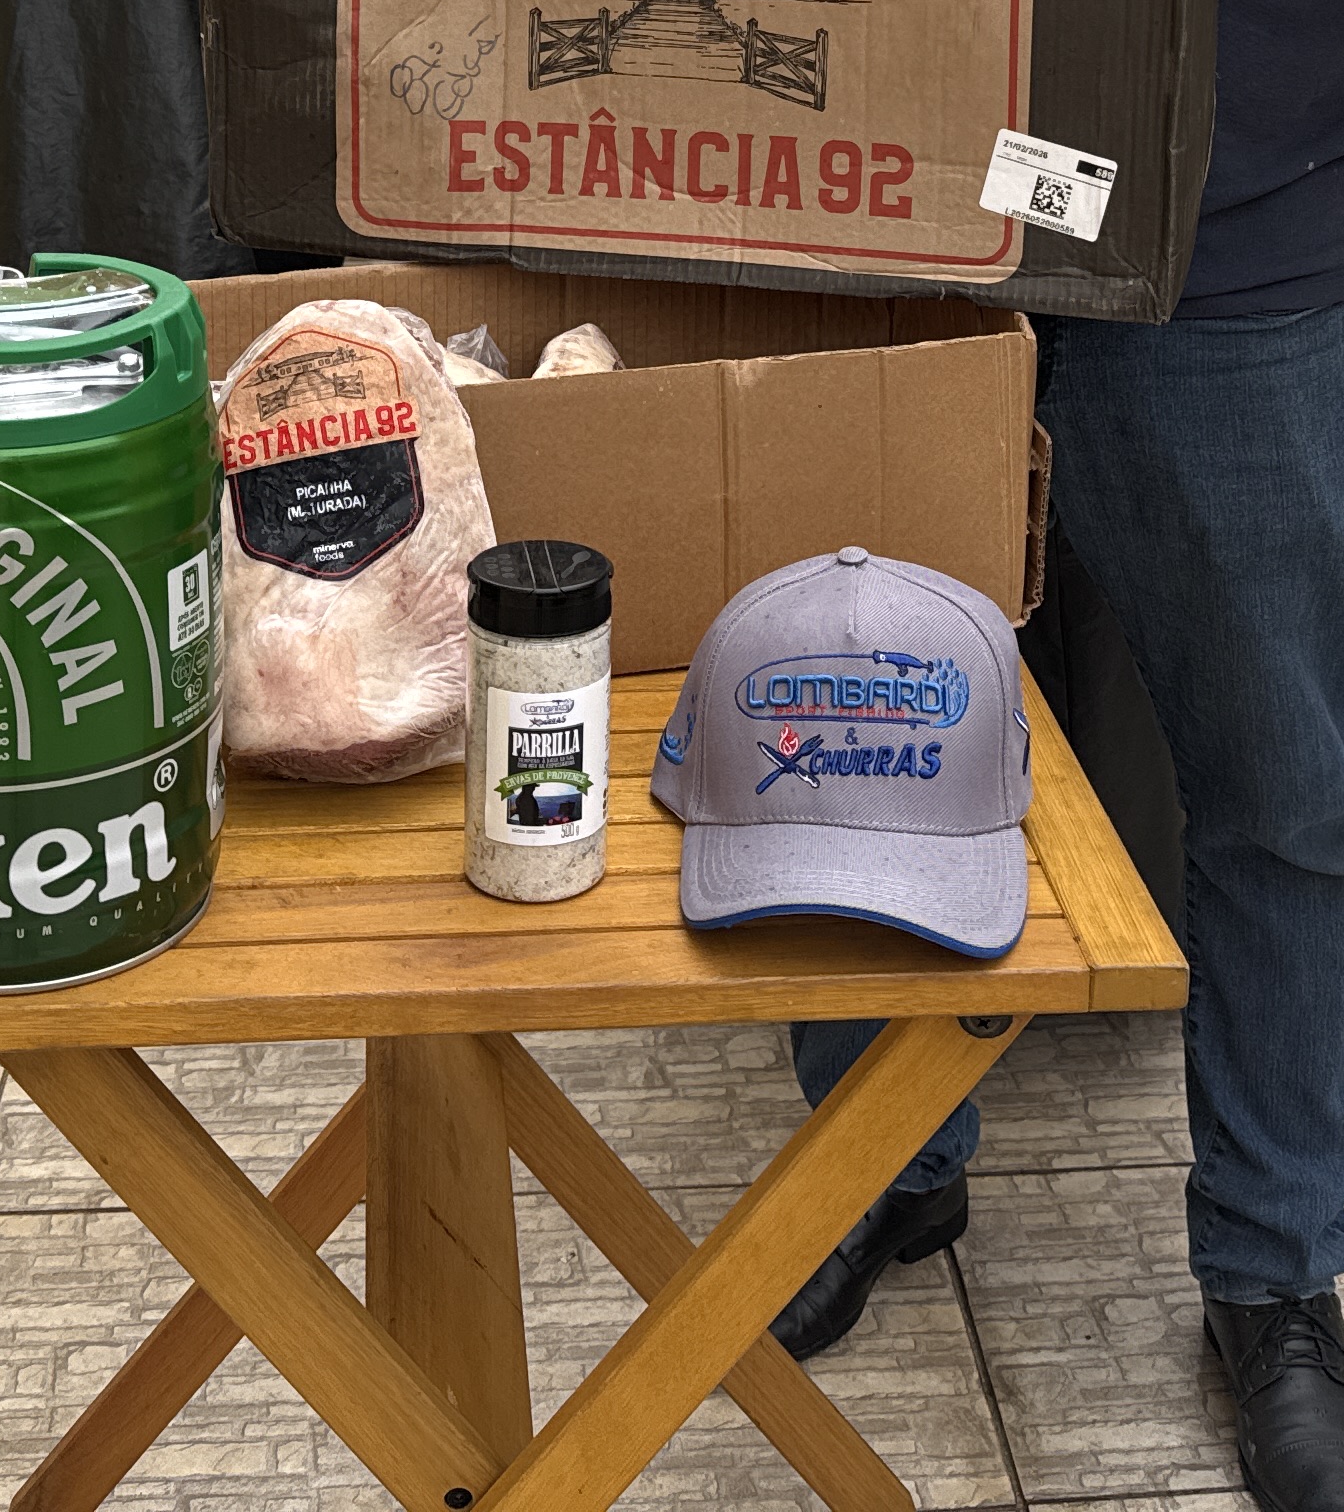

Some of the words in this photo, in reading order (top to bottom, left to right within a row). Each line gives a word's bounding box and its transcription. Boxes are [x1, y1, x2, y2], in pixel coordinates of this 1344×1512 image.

[313, 541, 354, 553] minerva
[315, 552, 344, 562] foods
[774, 705, 827, 715] SPORT
[838, 706, 905, 719] FISHING
[512, 729, 581, 758] PARRILLA
[809, 741, 942, 779] CHURRAS
[533, 771, 545, 780] DE
